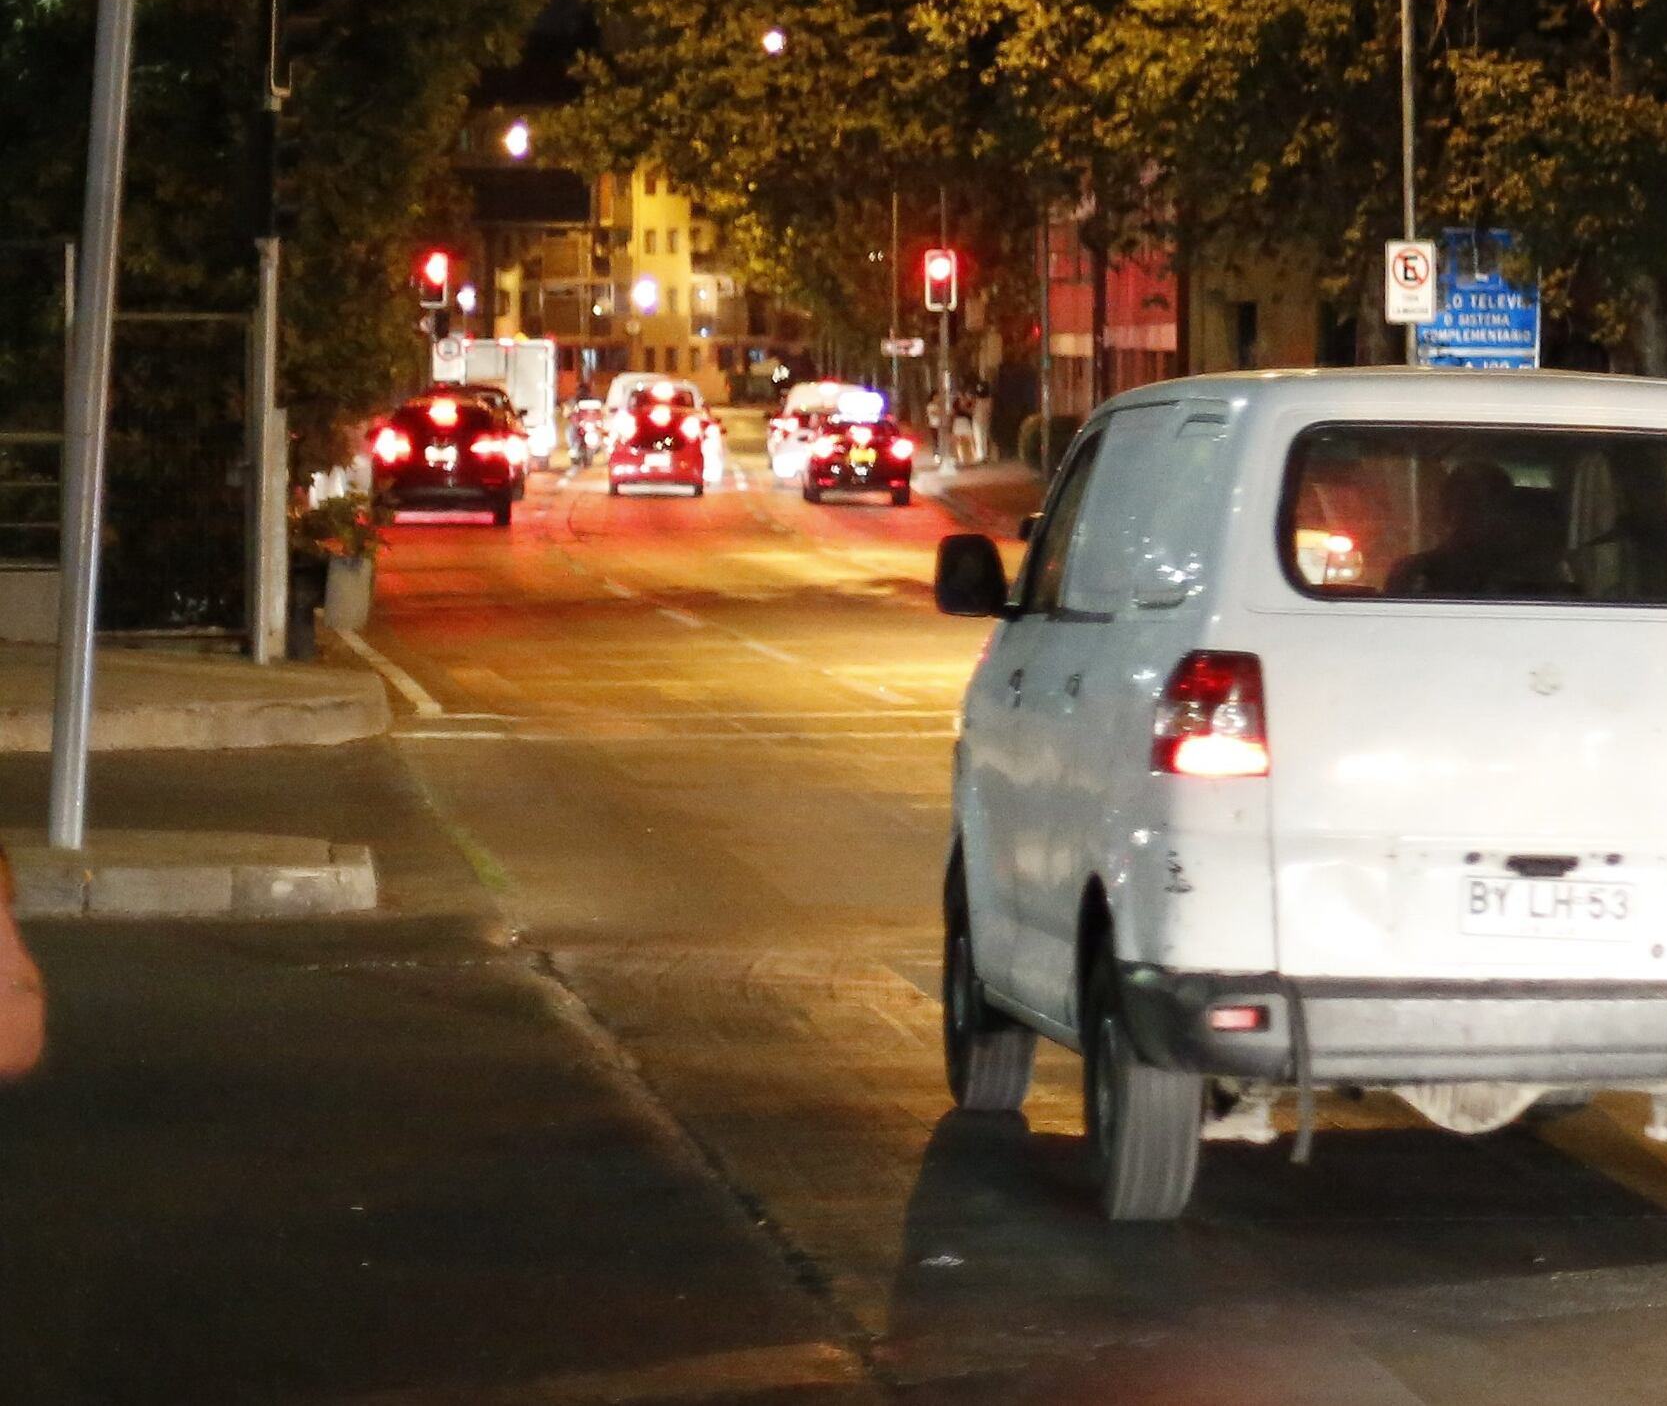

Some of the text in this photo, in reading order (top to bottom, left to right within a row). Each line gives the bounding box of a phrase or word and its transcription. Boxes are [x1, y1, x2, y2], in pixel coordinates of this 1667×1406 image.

[1460, 313, 1510, 327] SISTEMA
[1424, 328, 1532, 344] COMPLEMENTARIO
[1469, 880, 1511, 916] BY
